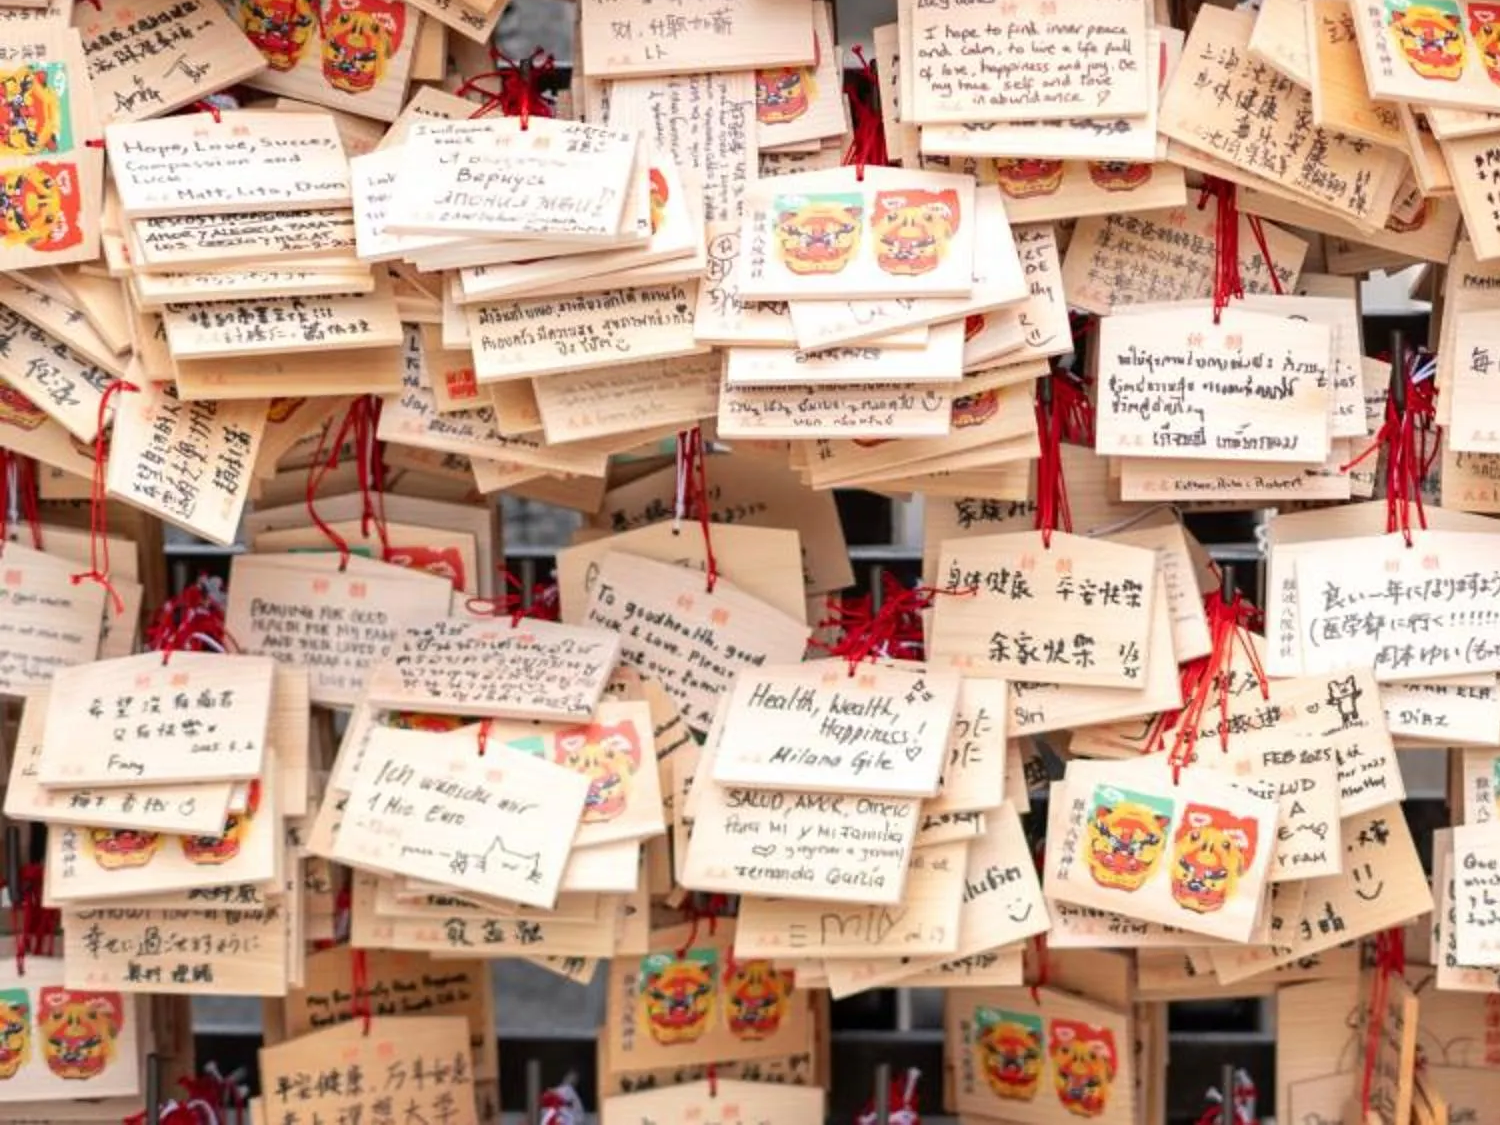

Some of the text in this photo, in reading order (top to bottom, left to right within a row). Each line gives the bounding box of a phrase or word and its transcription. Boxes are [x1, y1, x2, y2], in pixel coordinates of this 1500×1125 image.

[944, 25, 981, 46] hope
[986, 23, 1002, 36] to
[1007, 21, 1040, 41] find
[1046, 23, 1081, 36] inner
[1085, 25, 1129, 42] peace
[918, 42, 952, 58] and
[1008, 42, 1025, 55] to
[1031, 42, 1057, 55] live
[1077, 41, 1098, 61] life
[1104, 38, 1133, 56] full
[918, 67, 933, 83] of
[980, 57, 1051, 81] happiness
[1057, 58, 1082, 71] and
[930, 73, 1113, 98] my true self and love
[972, 91, 1084, 106] in abundance
[747, 682, 901, 724] Health, Wealth,
[1463, 852, 1498, 870] Que
